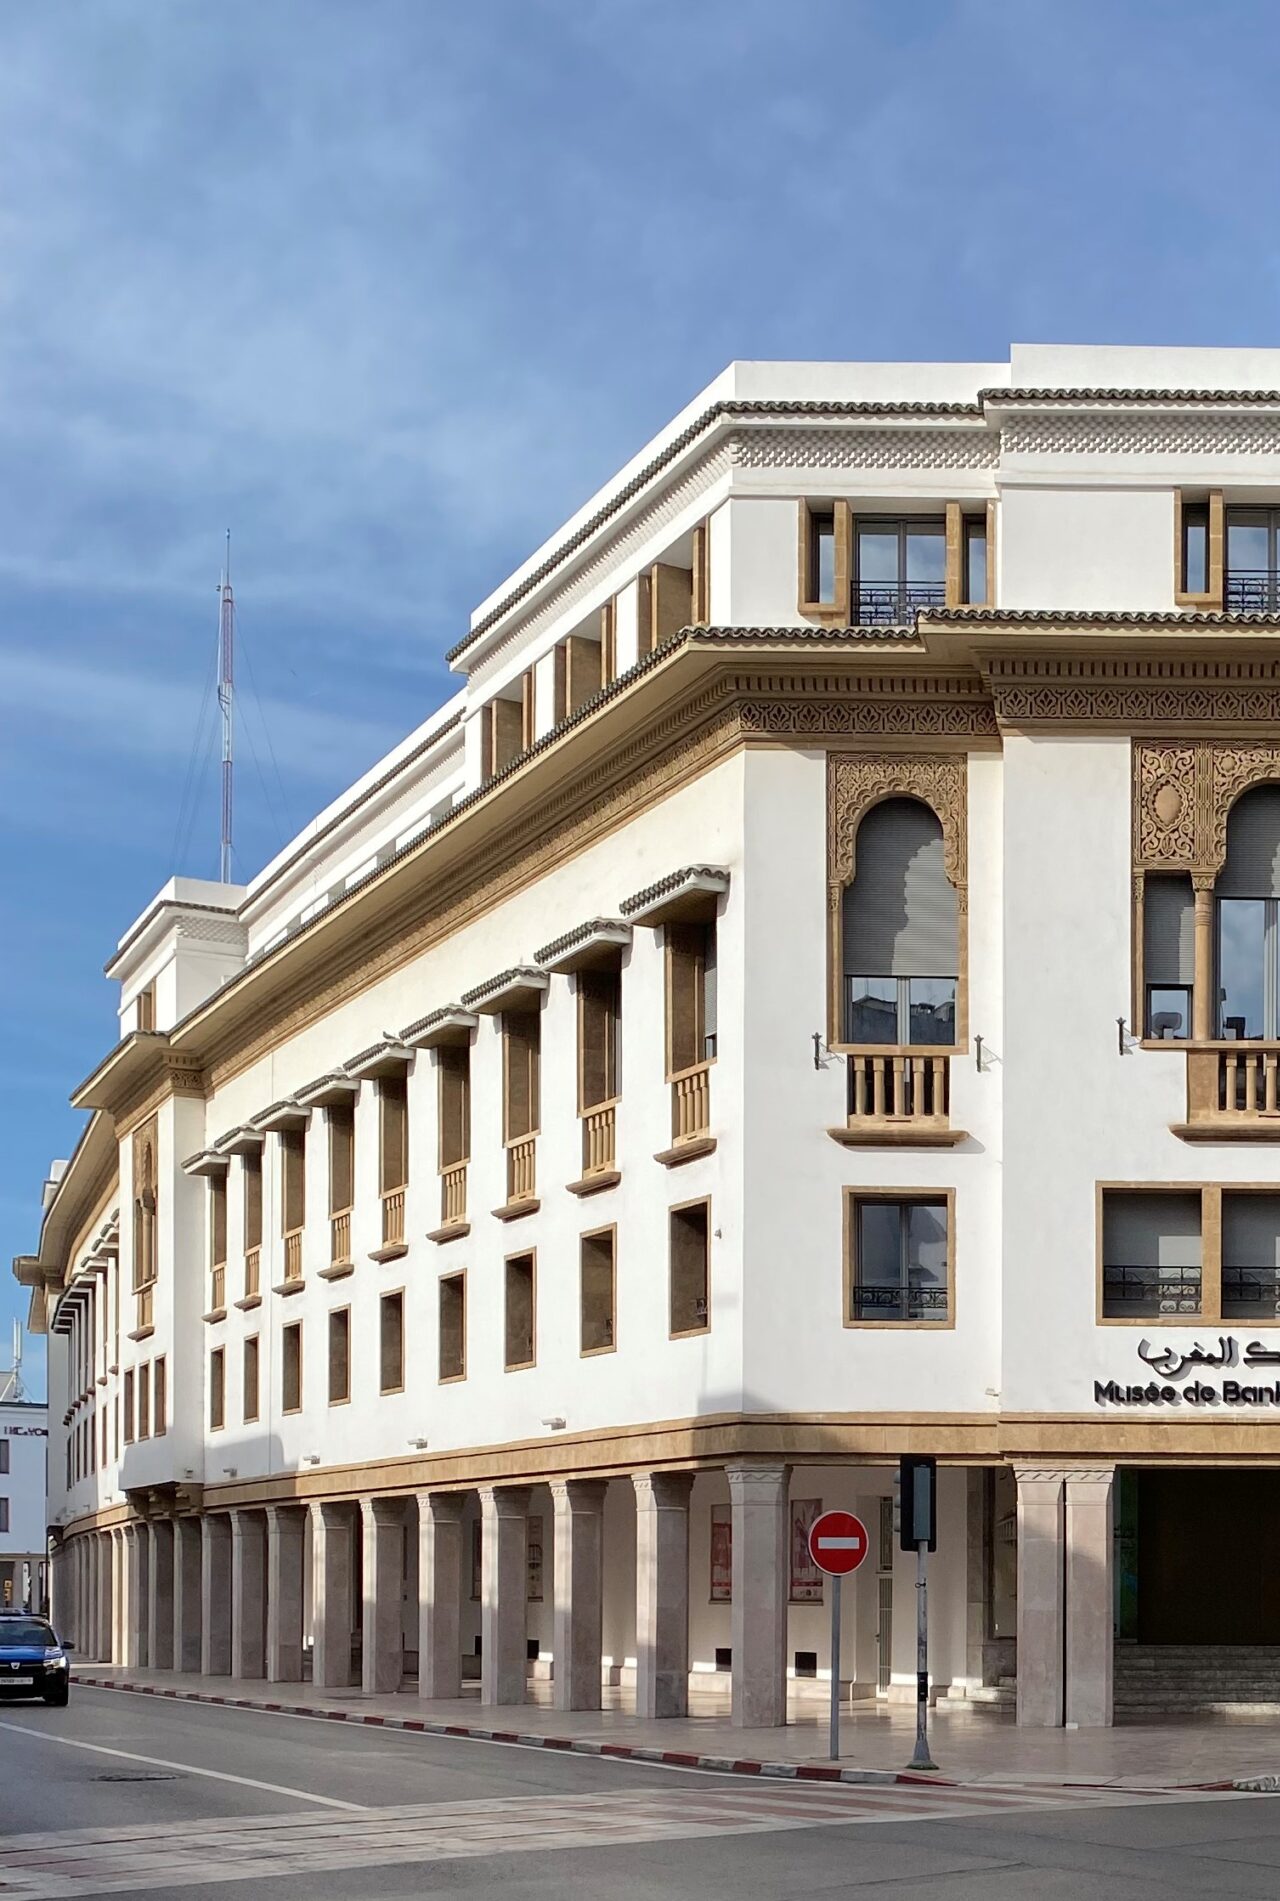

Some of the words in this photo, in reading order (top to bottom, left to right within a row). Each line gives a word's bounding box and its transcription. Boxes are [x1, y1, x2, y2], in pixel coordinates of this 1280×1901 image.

[1137, 1336, 1234, 1378] المغرب
[1094, 1380, 1177, 1405] Musée
[1182, 1380, 1216, 1404] de
